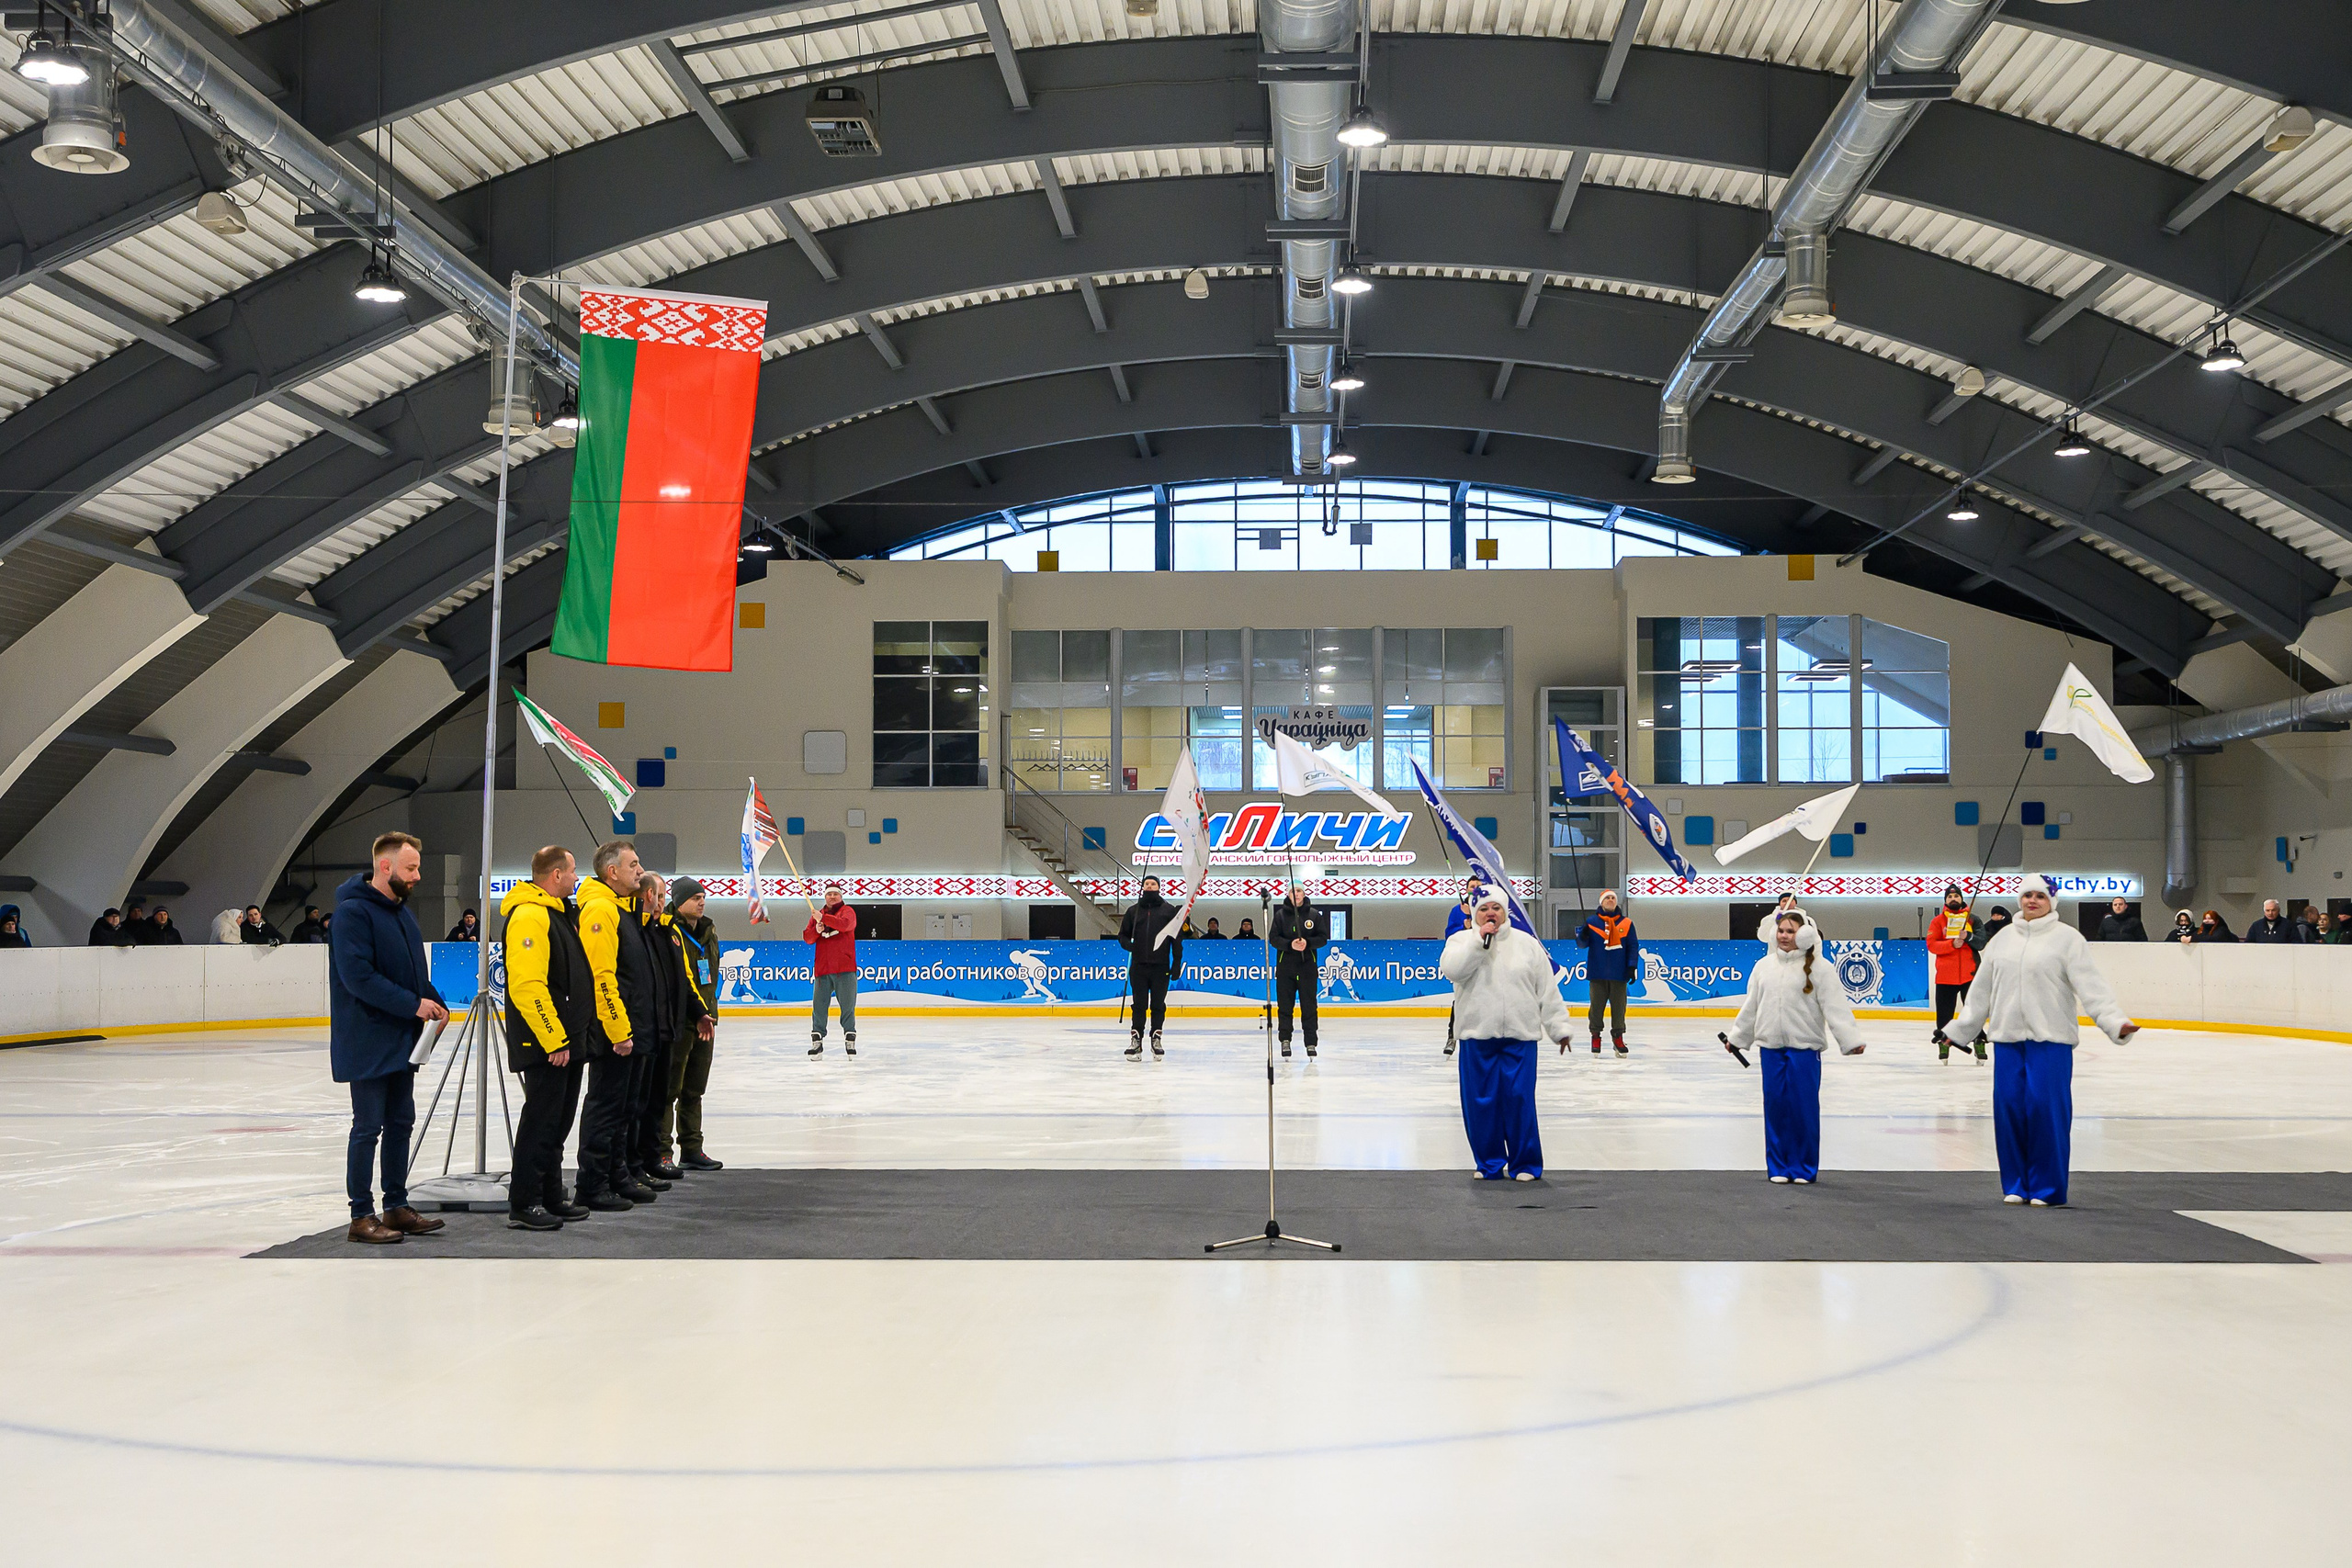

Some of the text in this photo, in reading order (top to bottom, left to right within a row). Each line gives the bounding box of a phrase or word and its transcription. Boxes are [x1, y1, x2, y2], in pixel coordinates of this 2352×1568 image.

[1293, 710, 1334, 719] КАФЕ
[1134, 852, 1413, 864] РЕСПУБАНСКИЙ ГОРНОЛЫЖНЫЙ ЦЕНТР
[906, 959, 1030, 985] работников
[1644, 961, 1743, 986] Беларусь
[601, 982, 619, 1021] BELARUS
[534, 998, 554, 1034] BELARUS
